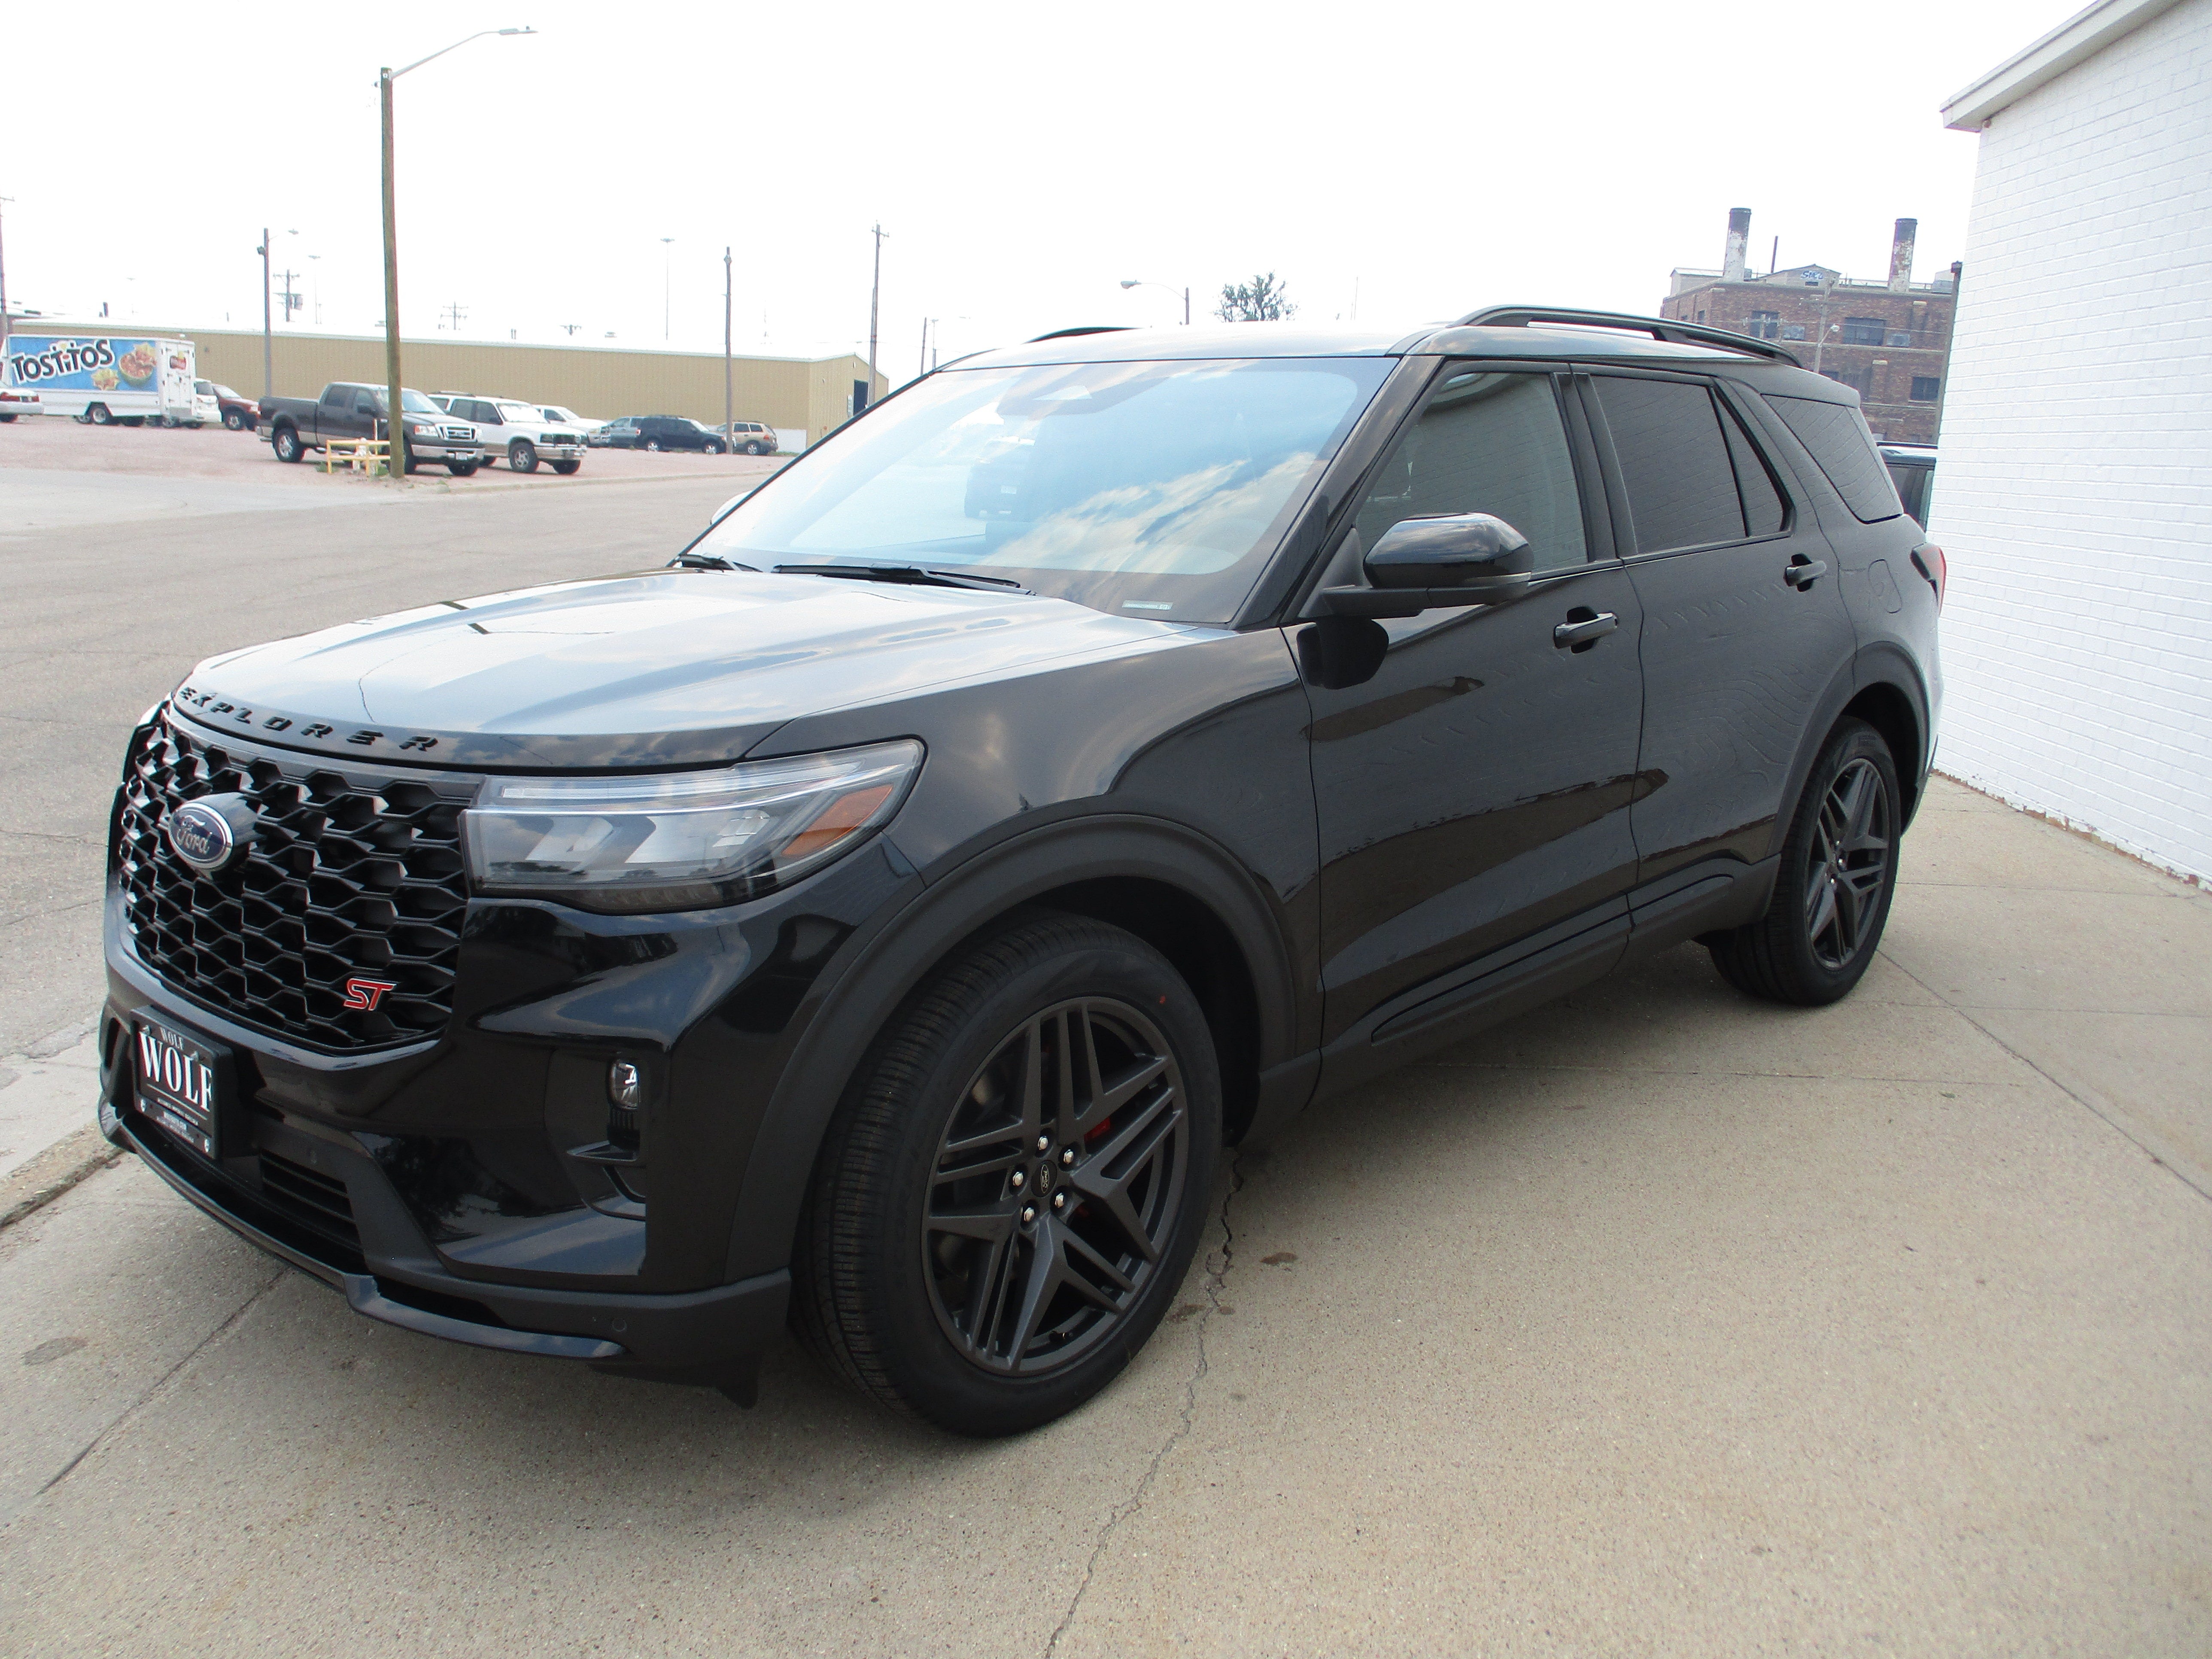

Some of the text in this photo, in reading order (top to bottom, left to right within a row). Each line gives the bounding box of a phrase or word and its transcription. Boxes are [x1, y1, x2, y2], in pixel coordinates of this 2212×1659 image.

[179, 687, 438, 752] EXPLORER
[176, 815, 212, 855] Ford
[343, 978, 397, 1011] ST
[138, 1031, 212, 1112] WOLF
